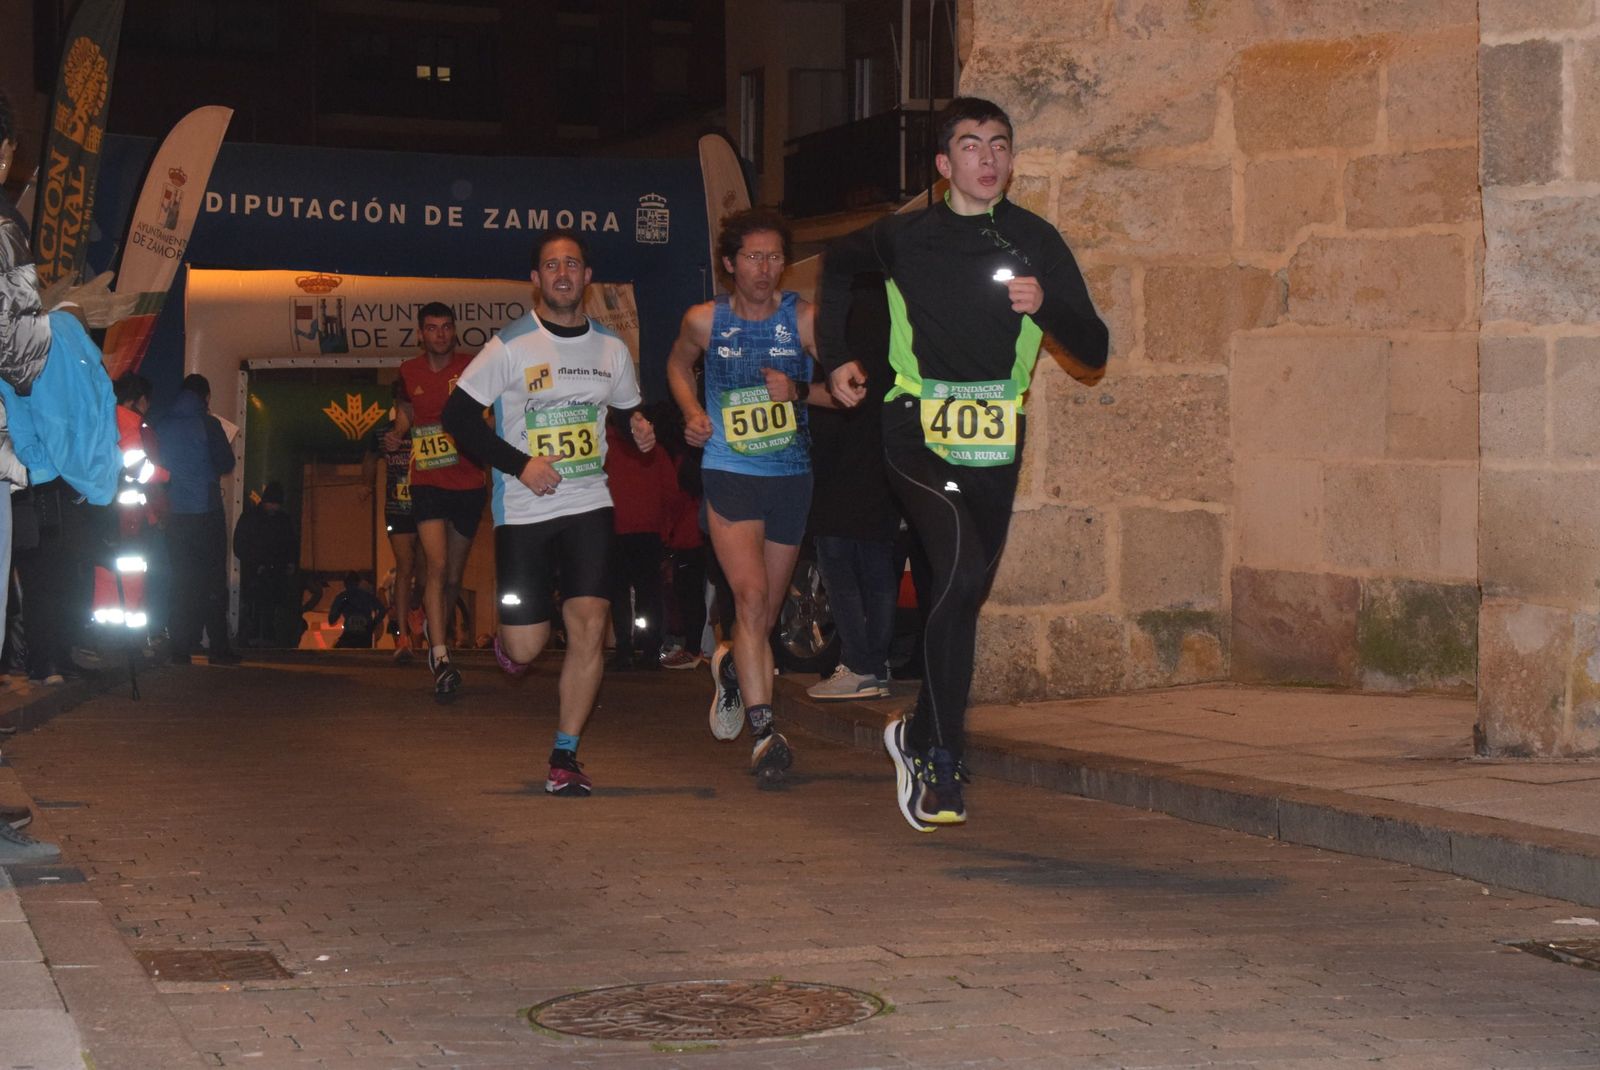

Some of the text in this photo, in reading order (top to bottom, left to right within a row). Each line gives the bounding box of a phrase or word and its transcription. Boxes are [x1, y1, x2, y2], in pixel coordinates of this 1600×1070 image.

[205, 191, 621, 233] DIPUTACIÓN DE ZAMORA
[137, 221, 187, 248] AYUNTAMIENT
[133, 231, 183, 260] DE ZAMOR
[351, 302, 525, 322] AYUNTIENTO
[351, 328, 388, 348] DE
[951, 384, 1005, 393] FUNDACION
[731, 403, 787, 436] 500
[930, 403, 1005, 439] 403
[420, 435, 449, 455] 415
[537, 428, 594, 459] 553
[748, 441, 768, 451] CAJA
[951, 451, 1010, 460] CAJA RURAL
[575, 462, 599, 473] RURAL
